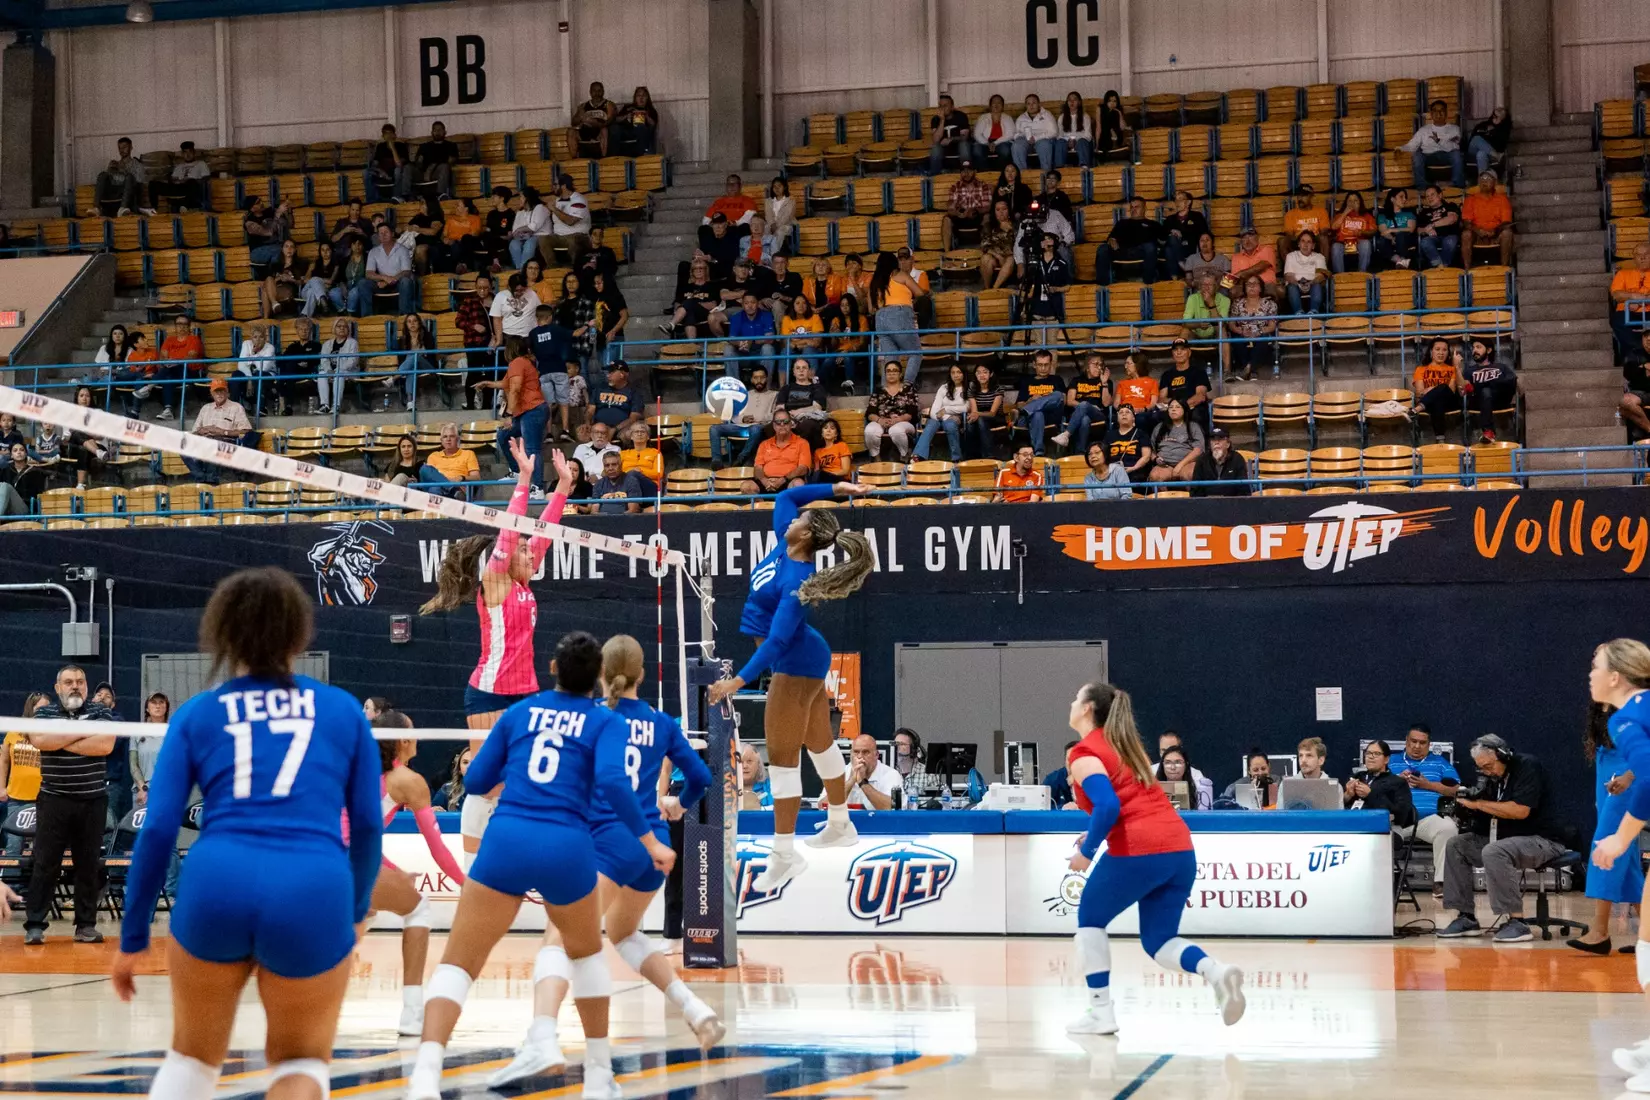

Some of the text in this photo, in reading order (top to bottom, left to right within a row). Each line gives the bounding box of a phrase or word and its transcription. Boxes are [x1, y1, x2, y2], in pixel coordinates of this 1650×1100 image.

[1026, 0, 1099, 69] CC
[419, 35, 486, 107] BB
[1473, 368, 1502, 383] UTEP
[623, 533, 669, 579] TO
[924, 525, 1011, 571] GYM
[1085, 501, 1403, 574] HOME OF UTEP
[1474, 494, 1649, 573] Volley
[218, 688, 316, 724] TECH
[527, 706, 586, 738] TECH
[223, 718, 315, 799] 17
[527, 728, 564, 784] 6
[697, 840, 709, 916] sports imports
[854, 848, 952, 918] UTEP
[1246, 862, 1301, 880] DEL
[1308, 844, 1351, 873] UTEP
[1200, 890, 1308, 908] PUEBLO
[688, 928, 719, 938] UTEP
